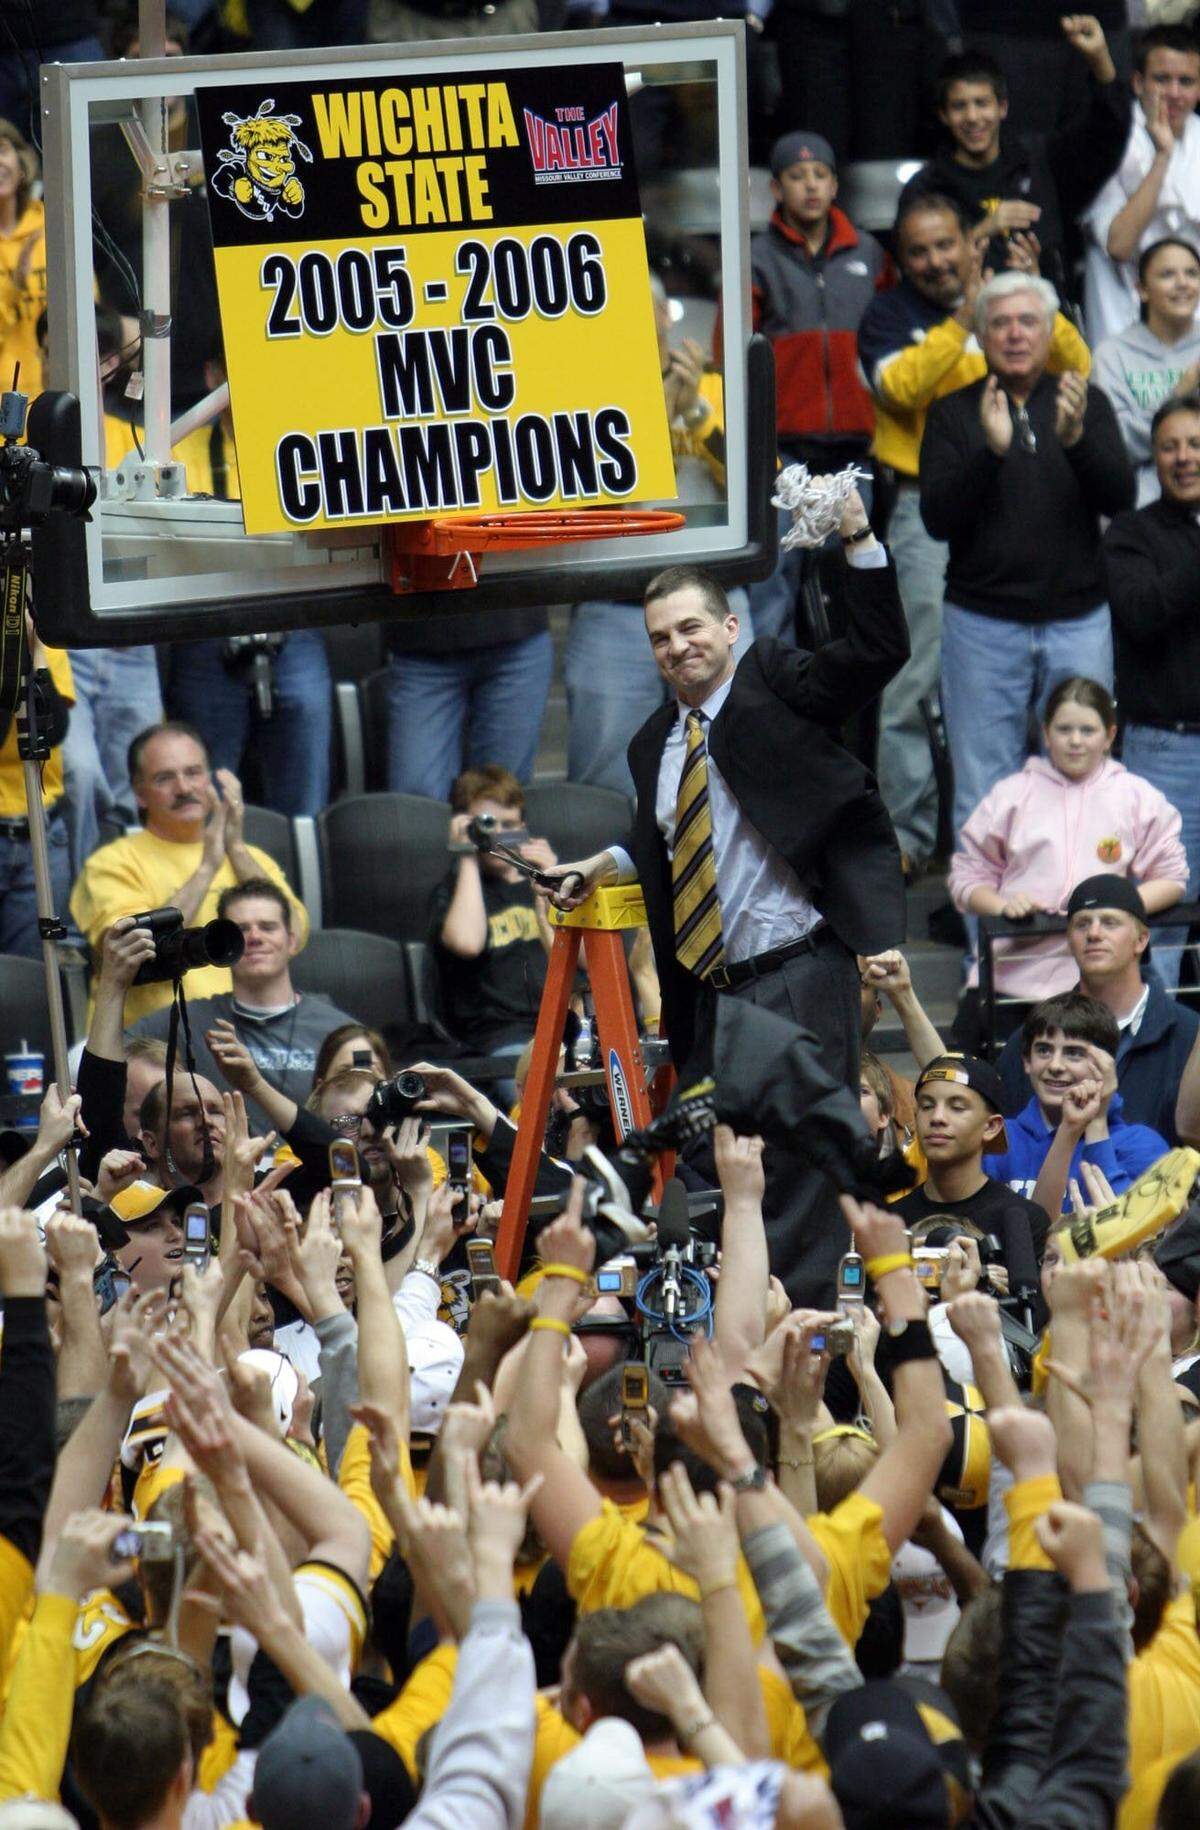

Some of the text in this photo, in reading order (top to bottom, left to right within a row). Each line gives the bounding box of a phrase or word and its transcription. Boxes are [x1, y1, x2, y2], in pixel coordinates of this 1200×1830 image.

[312, 82, 520, 159] WICHITA
[523, 101, 619, 171] VALLEY
[555, 106, 585, 122] THE
[356, 155, 493, 229] STATE
[535, 169, 621, 183] MISSOURI VALLEY CONFERENCE
[262, 246, 415, 337] 2005
[455, 231, 608, 322] 2006
[374, 323, 516, 420] MVC
[275, 407, 638, 523] CHAMPIONS
[8, 574, 21, 614] Nikon
